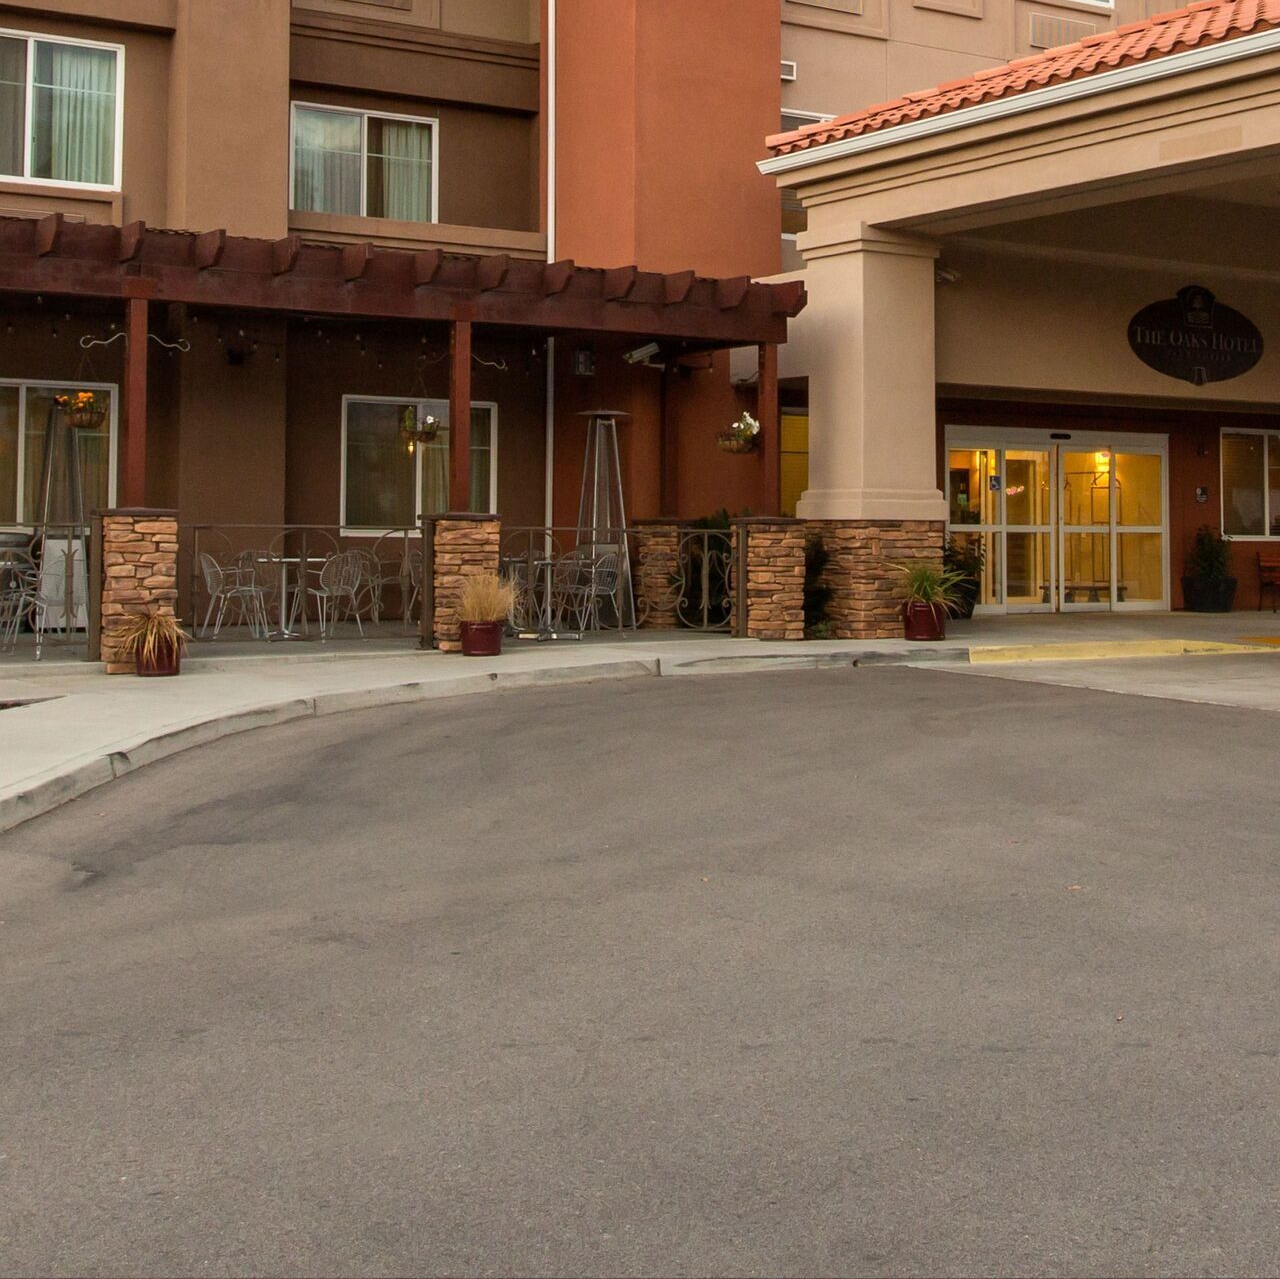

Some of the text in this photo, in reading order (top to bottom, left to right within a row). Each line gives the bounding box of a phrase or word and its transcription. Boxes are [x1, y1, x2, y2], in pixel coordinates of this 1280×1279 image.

[1134, 326, 1257, 353] THE OAKS HOTEL
